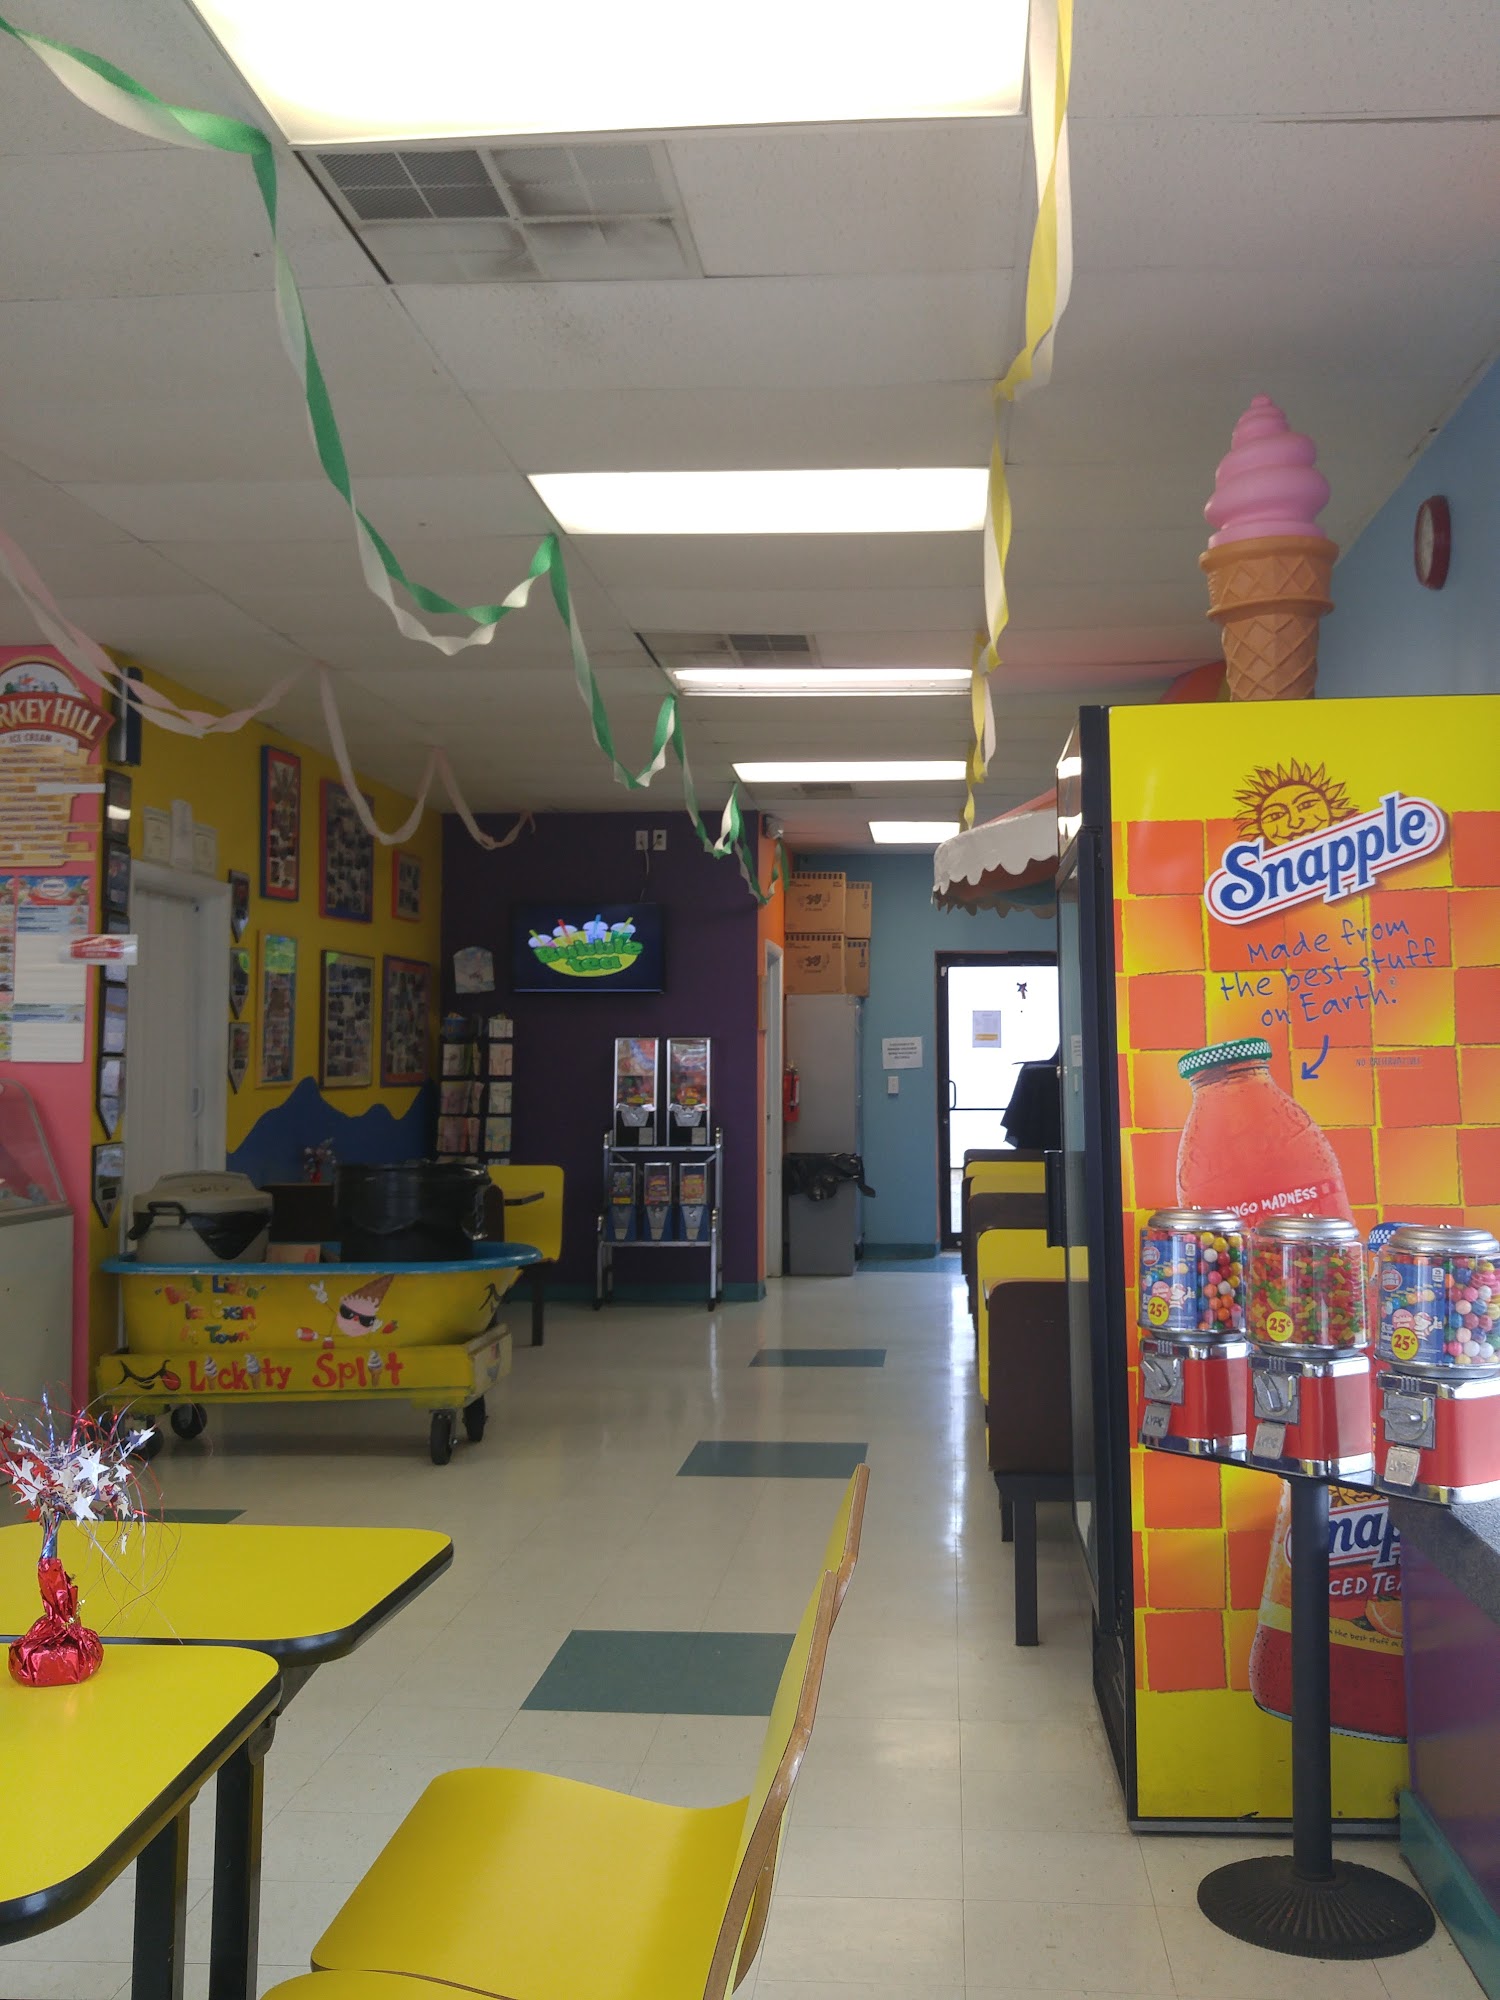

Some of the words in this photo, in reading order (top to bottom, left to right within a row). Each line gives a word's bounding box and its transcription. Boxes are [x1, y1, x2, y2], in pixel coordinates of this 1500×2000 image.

[52, 698, 102, 740] HILL
[23, 732, 53, 743] CREAM
[1220, 797, 1426, 911] Snapple
[1247, 932, 1331, 963] Made
[1341, 919, 1410, 946] from
[565, 956, 622, 973] tea
[1220, 972, 1273, 1001] the
[1281, 957, 1347, 991] best
[1359, 938, 1437, 977] stuff
[1261, 1007, 1292, 1027] on
[1227, 1202, 1258, 1218] NGO
[1261, 1187, 1318, 1210] MADNESS
[1269, 1317, 1291, 1333] 25¢
[1393, 1334, 1415, 1351] 25¢
[1328, 1512, 1401, 1563] nap
[1328, 1577, 1368, 1596] CED
[1372, 1571, 1402, 1595] TE
[1350, 1632, 1367, 1641] best
[1369, 1636, 1389, 1646] stuff
